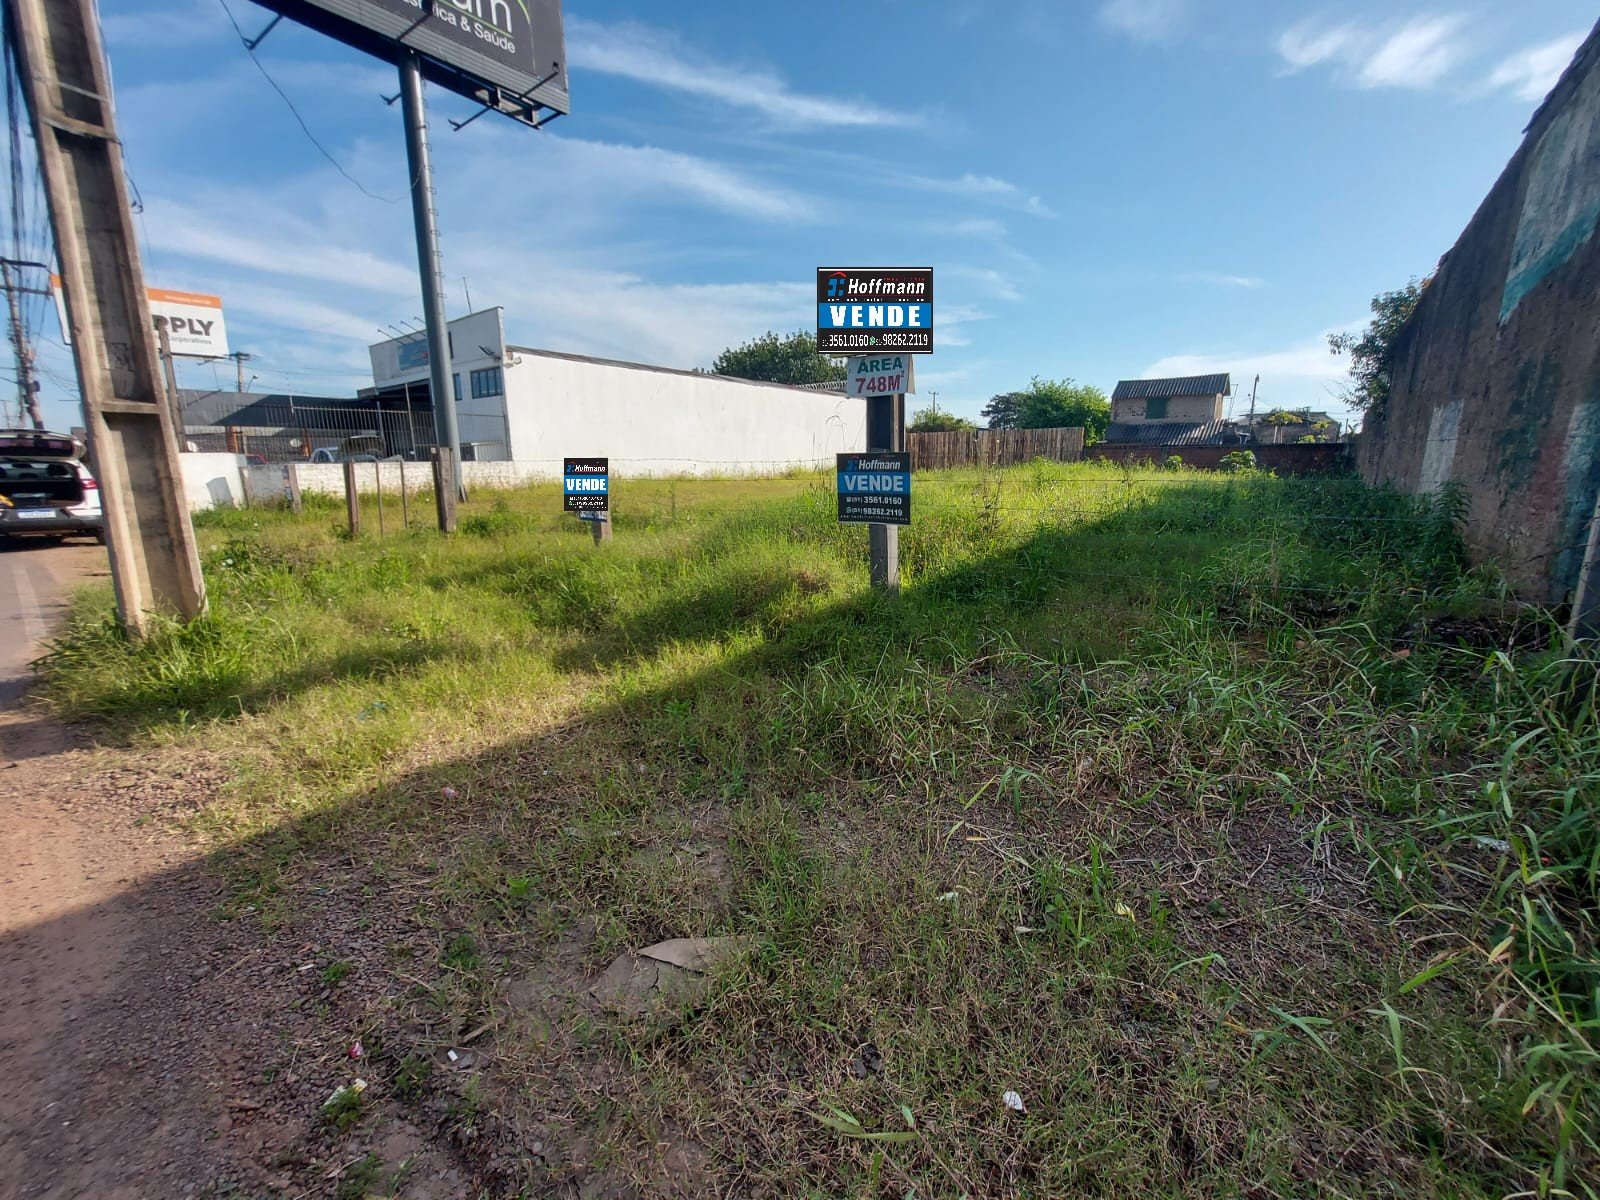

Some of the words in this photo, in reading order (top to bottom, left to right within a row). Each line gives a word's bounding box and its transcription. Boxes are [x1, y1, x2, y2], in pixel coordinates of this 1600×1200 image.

[460, 16, 471, 32] &
[474, 22, 515, 54] Saúde
[848, 279, 925, 295] Hoffmann
[829, 305, 921, 327] VENDE
[857, 356, 903, 374] ÁREA
[858, 460, 900, 469] Hoffmann
[566, 479, 606, 490] VENDE
[844, 474, 904, 492] VENDE
[863, 496, 902, 505] 3561.0160
